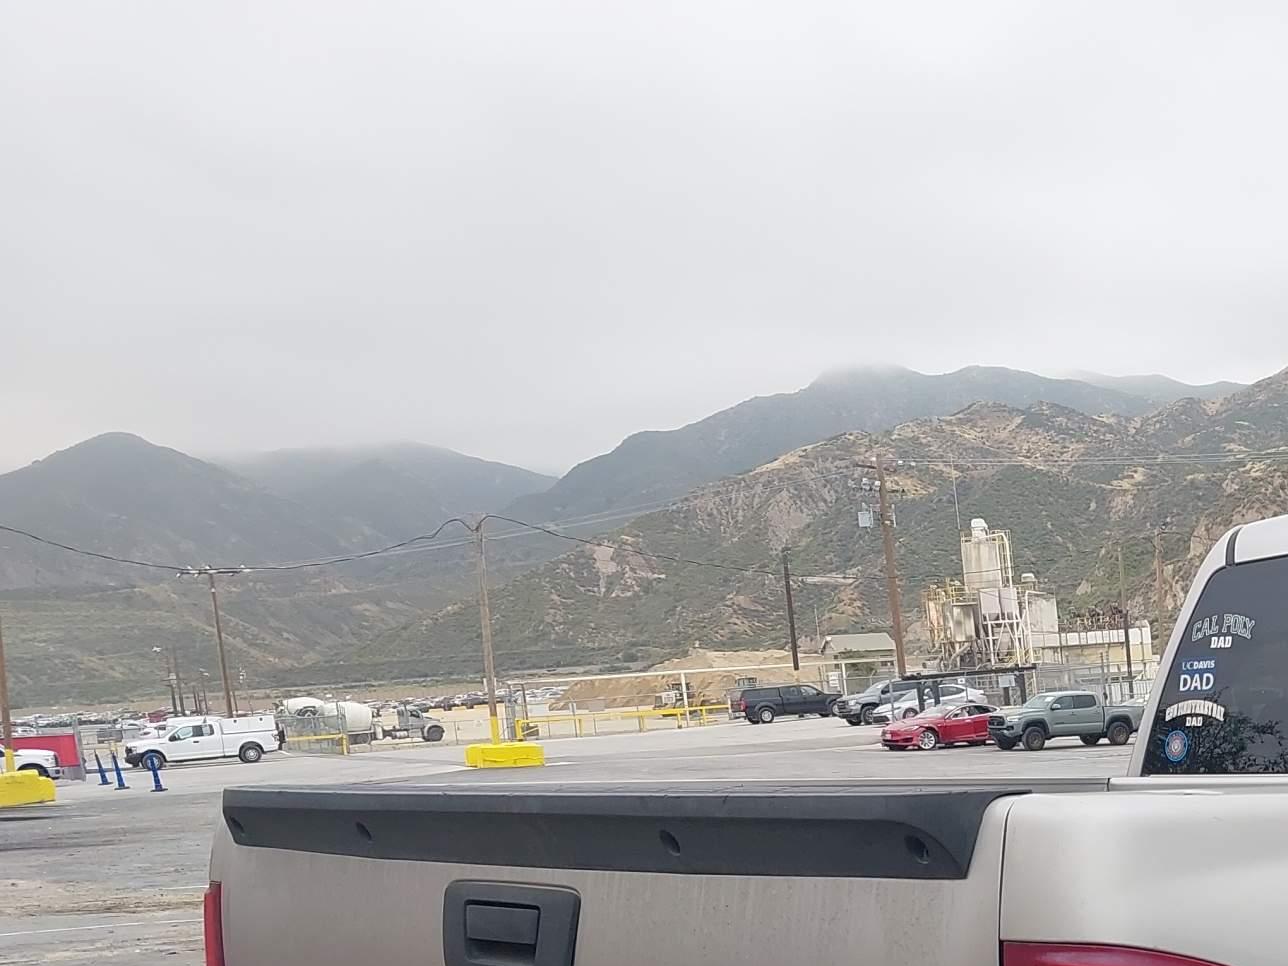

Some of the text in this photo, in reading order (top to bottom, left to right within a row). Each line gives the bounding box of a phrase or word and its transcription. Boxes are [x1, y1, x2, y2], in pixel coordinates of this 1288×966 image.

[1192, 614, 1255, 642] CAL POLY
[1210, 636, 1233, 649] DAD
[1179, 672, 1215, 692] DAD
[1185, 716, 1203, 726] DAD
